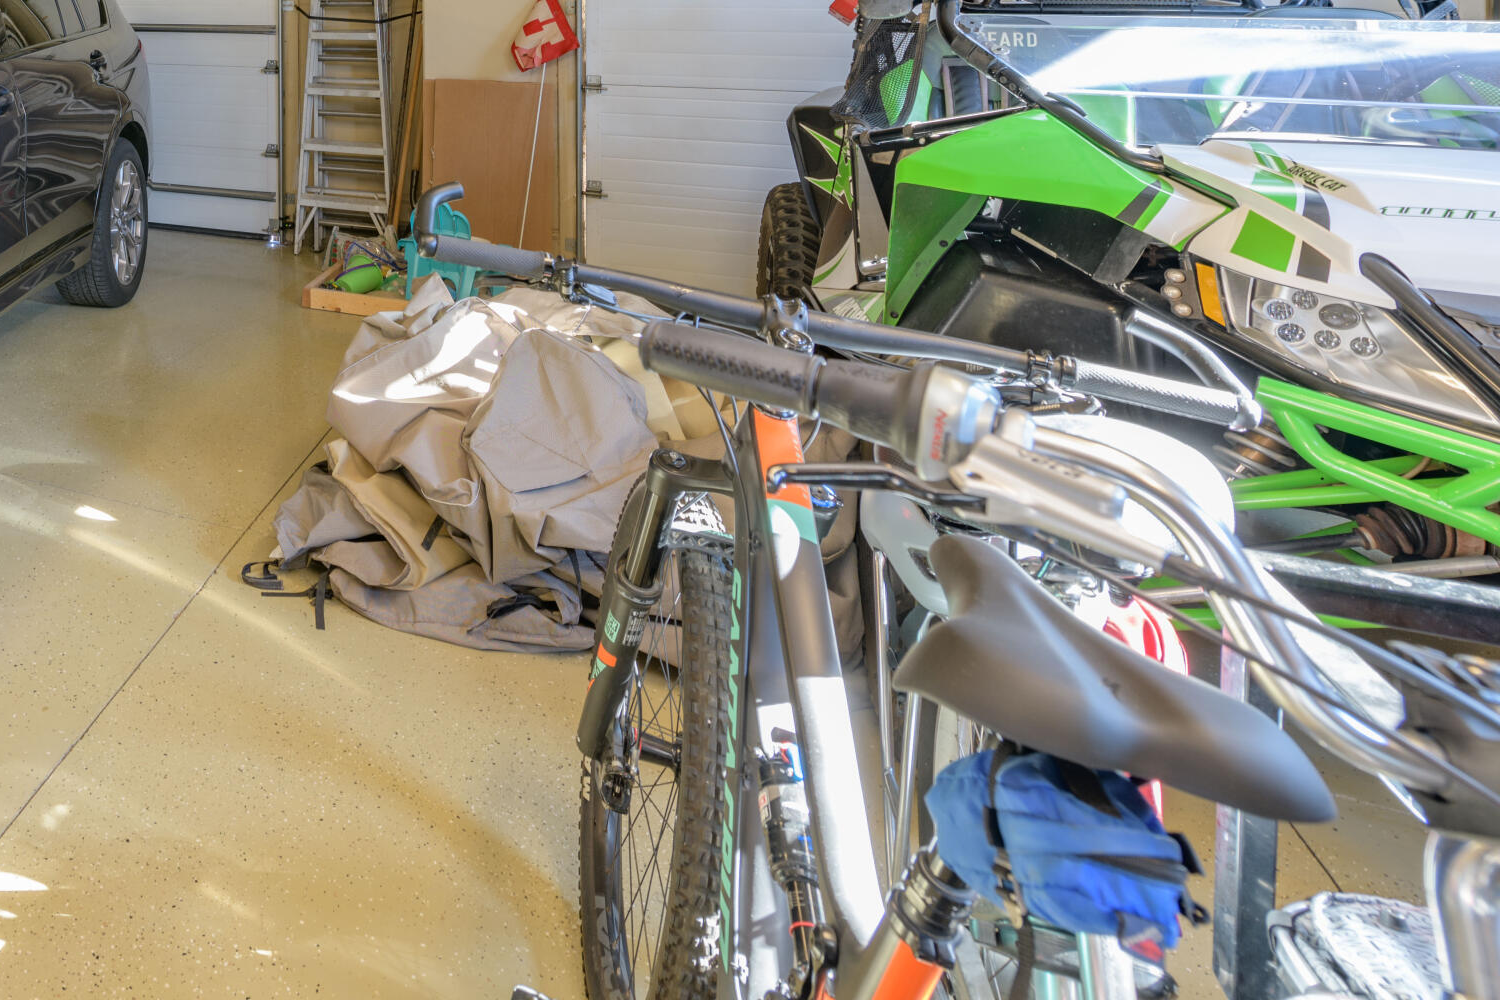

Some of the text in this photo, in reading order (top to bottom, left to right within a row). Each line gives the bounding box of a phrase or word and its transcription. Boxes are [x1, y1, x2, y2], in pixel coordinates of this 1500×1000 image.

[983, 31, 1038, 48] EARD
[1285, 164, 1347, 192] ARCTIC CAT
[726, 567, 742, 769] SANTA
